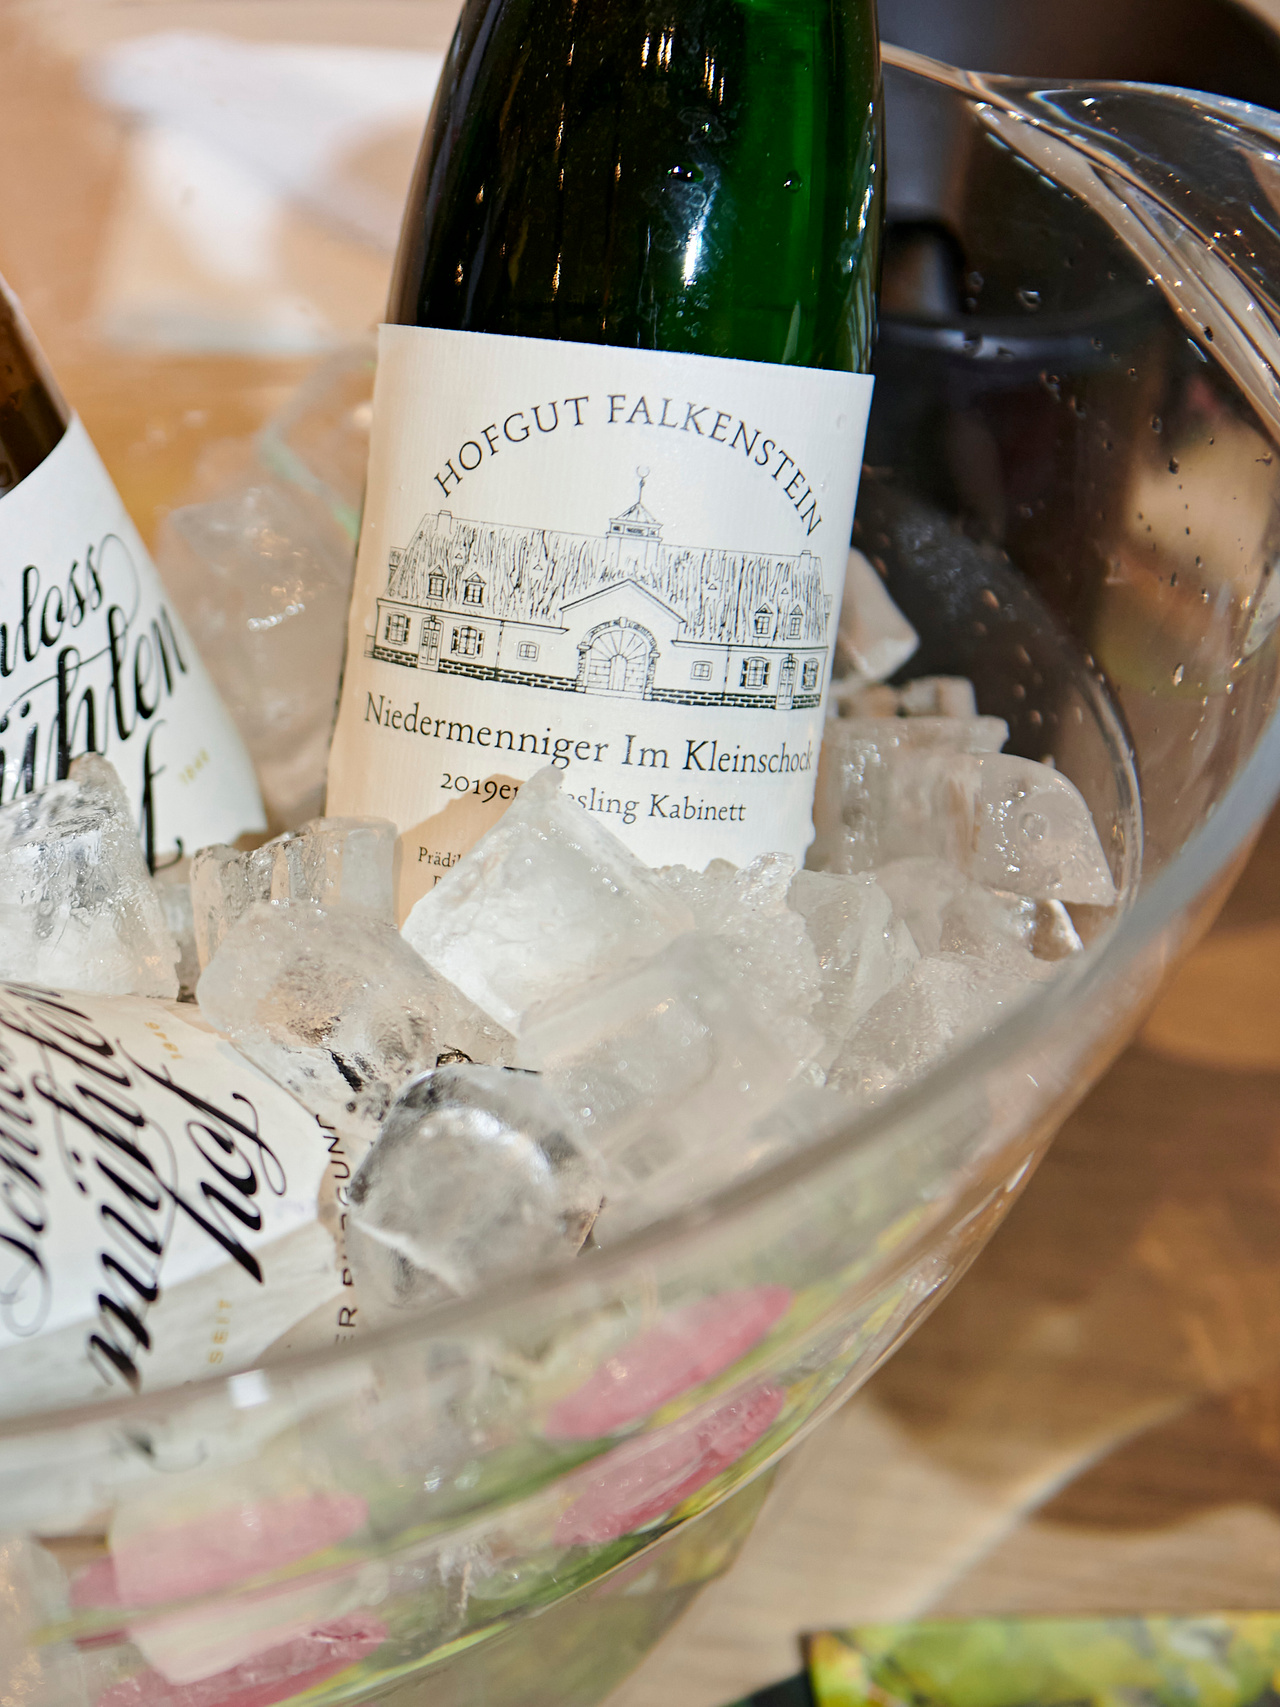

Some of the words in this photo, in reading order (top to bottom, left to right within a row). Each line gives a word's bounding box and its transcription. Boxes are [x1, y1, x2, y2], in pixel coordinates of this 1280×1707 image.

[433, 395, 590, 499] HOFGUT
[606, 394, 823, 537] FALKENSTEIN
[363, 691, 609, 770] Niedermenniger
[621, 734, 670, 770] Im
[683, 739, 814, 775] Kleinschock
[648, 793, 747, 822] Kabinett
[208, 1298, 233, 1365] SEIT
